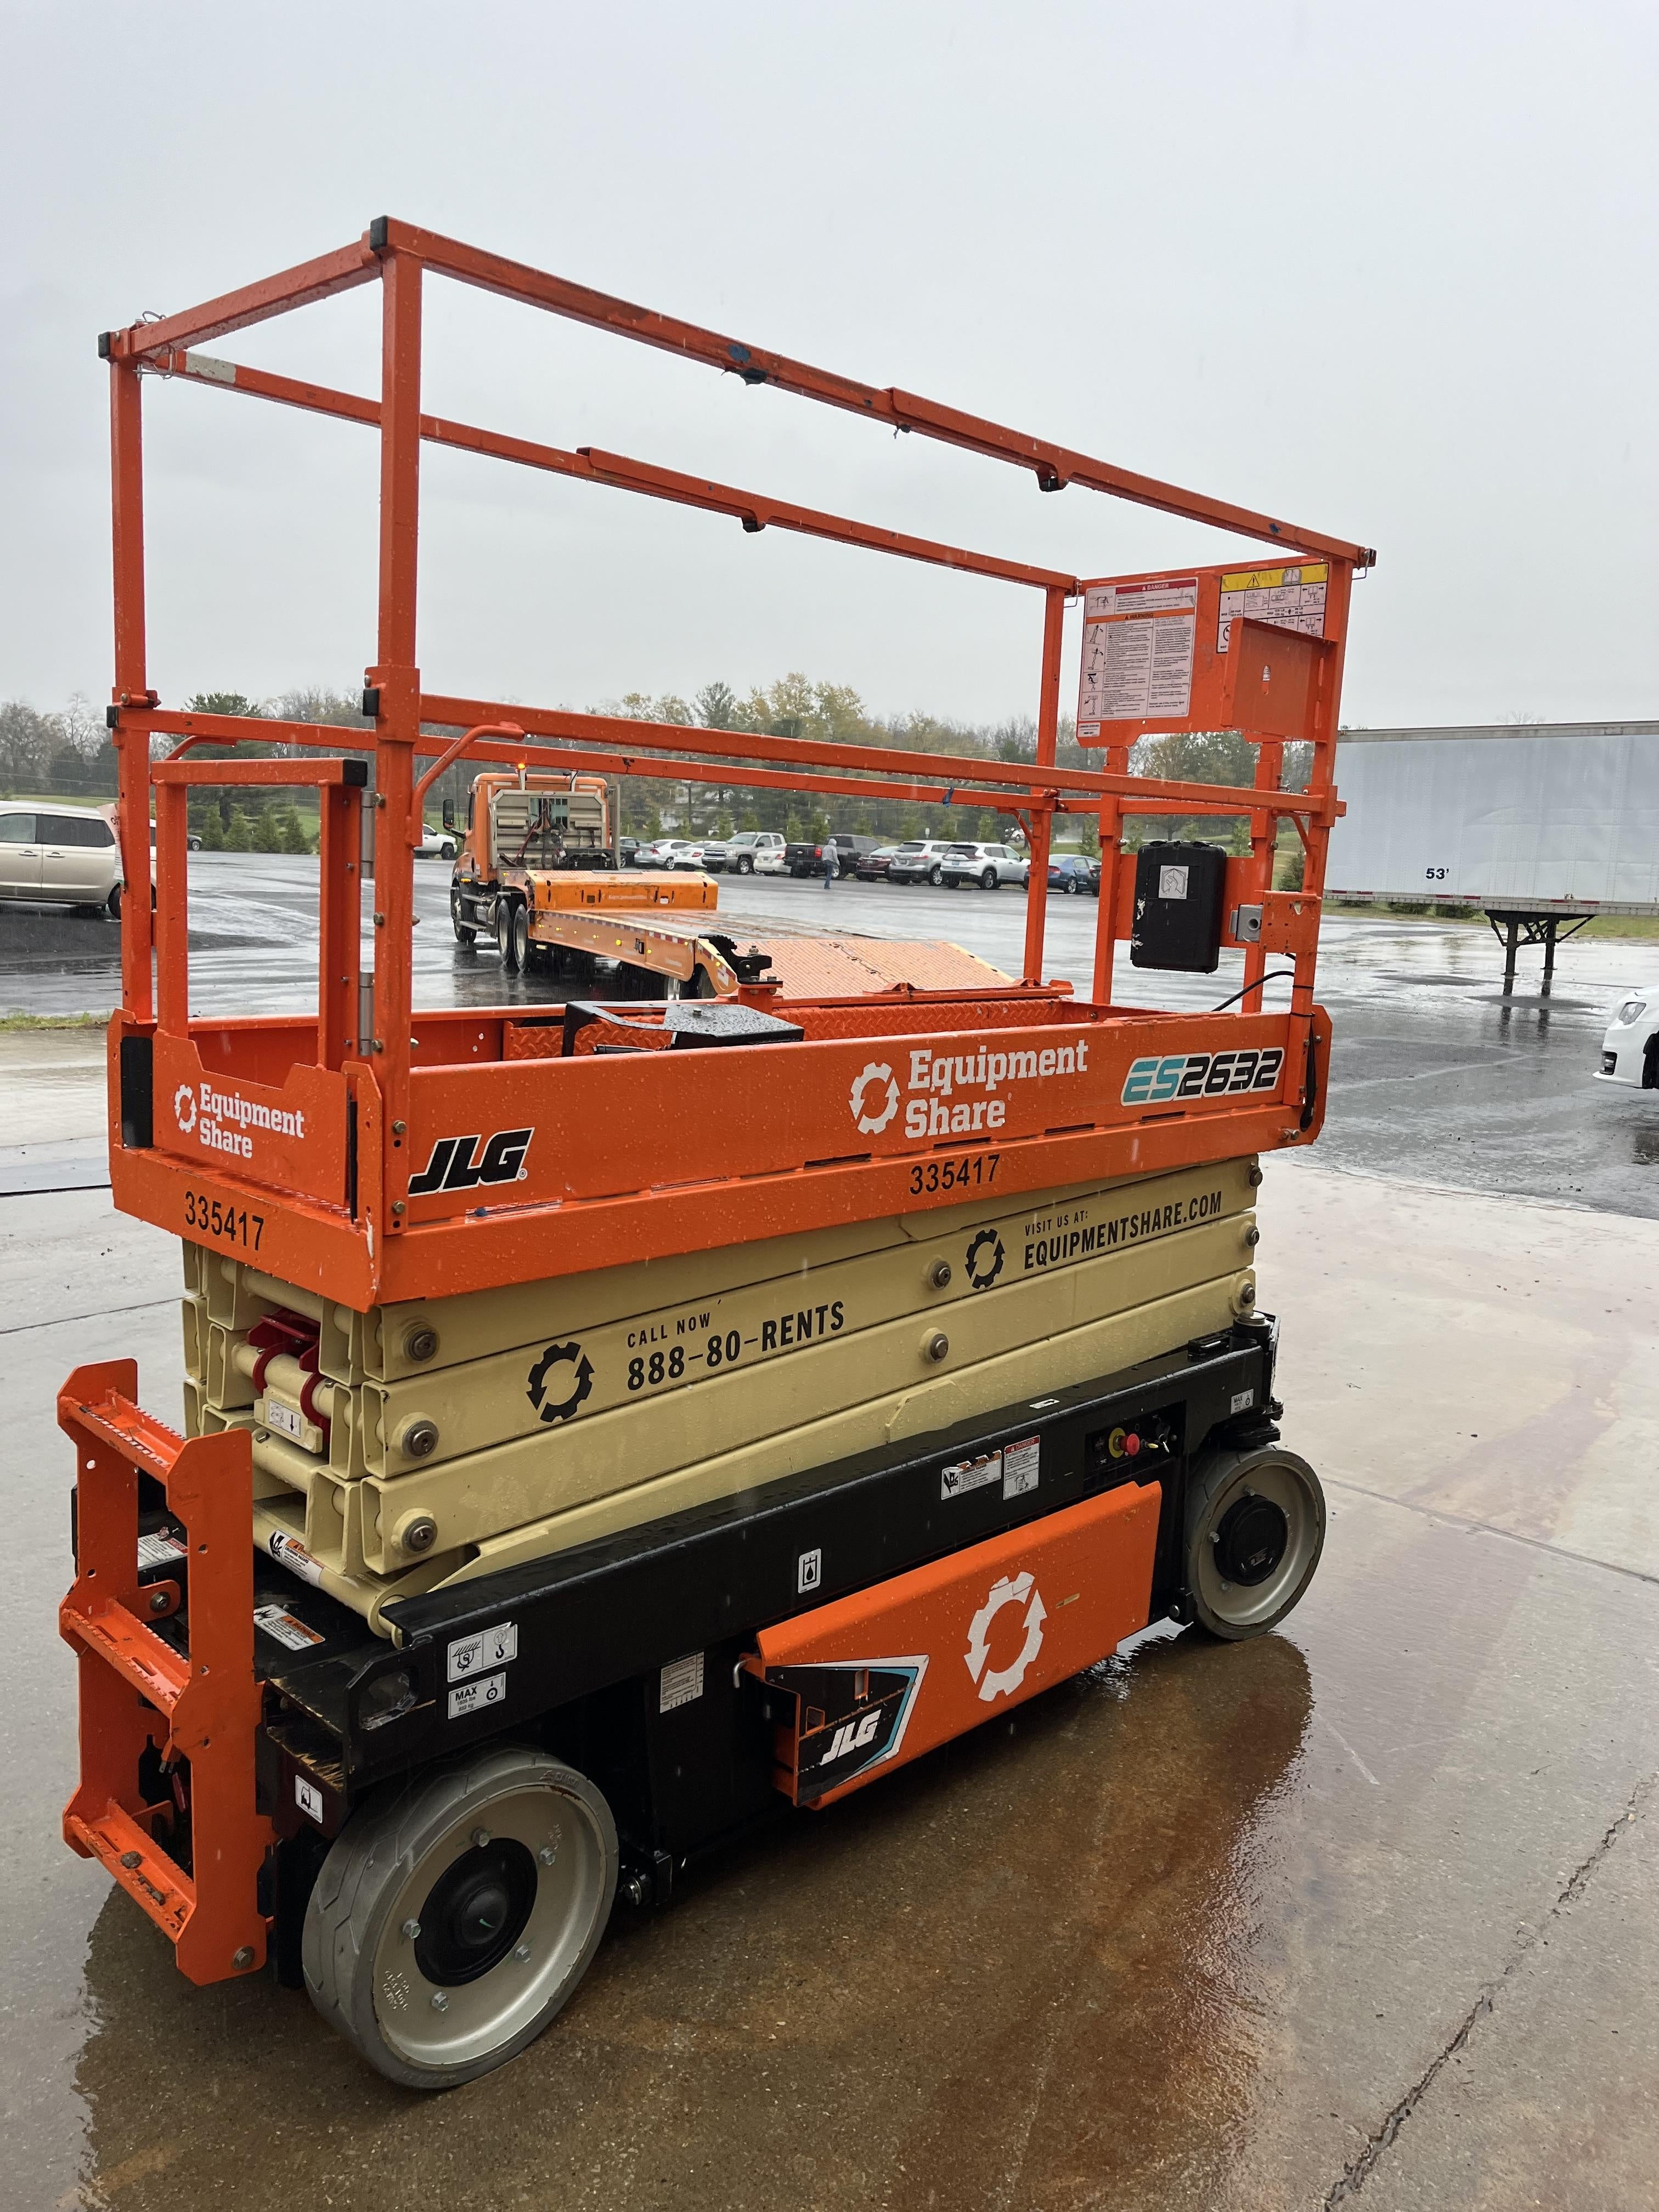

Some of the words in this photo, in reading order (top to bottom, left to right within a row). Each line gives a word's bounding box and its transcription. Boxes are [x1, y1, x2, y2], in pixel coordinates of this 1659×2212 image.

[1426, 867, 1449, 879] 53'
[907, 1039, 1089, 1096] Equipment
[1122, 1047, 1284, 1107] ES2632
[199, 1082, 305, 1139] Equipment
[905, 1098, 1006, 1139] Share
[199, 1118, 253, 1159] Share
[408, 1127, 535, 1197] JLG
[909, 1154, 1001, 1196] 335417
[184, 1190, 264, 1251] 335417
[1024, 1191, 1222, 1270] EQUIPMENTSHARE.COM
[1025, 1218, 1052, 1237] VISIT
[1057, 1214, 1069, 1228] US
[1074, 1210, 1088, 1223] AT:
[627, 1324, 668, 1348] CALL
[676, 1312, 710, 1335] NOW
[627, 1301, 844, 1391] 888-80-RENTS
[1015, 1438, 1035, 1449] DANGER
[455, 1686, 477, 1701] MAX
[820, 1709, 882, 1765] JLG
